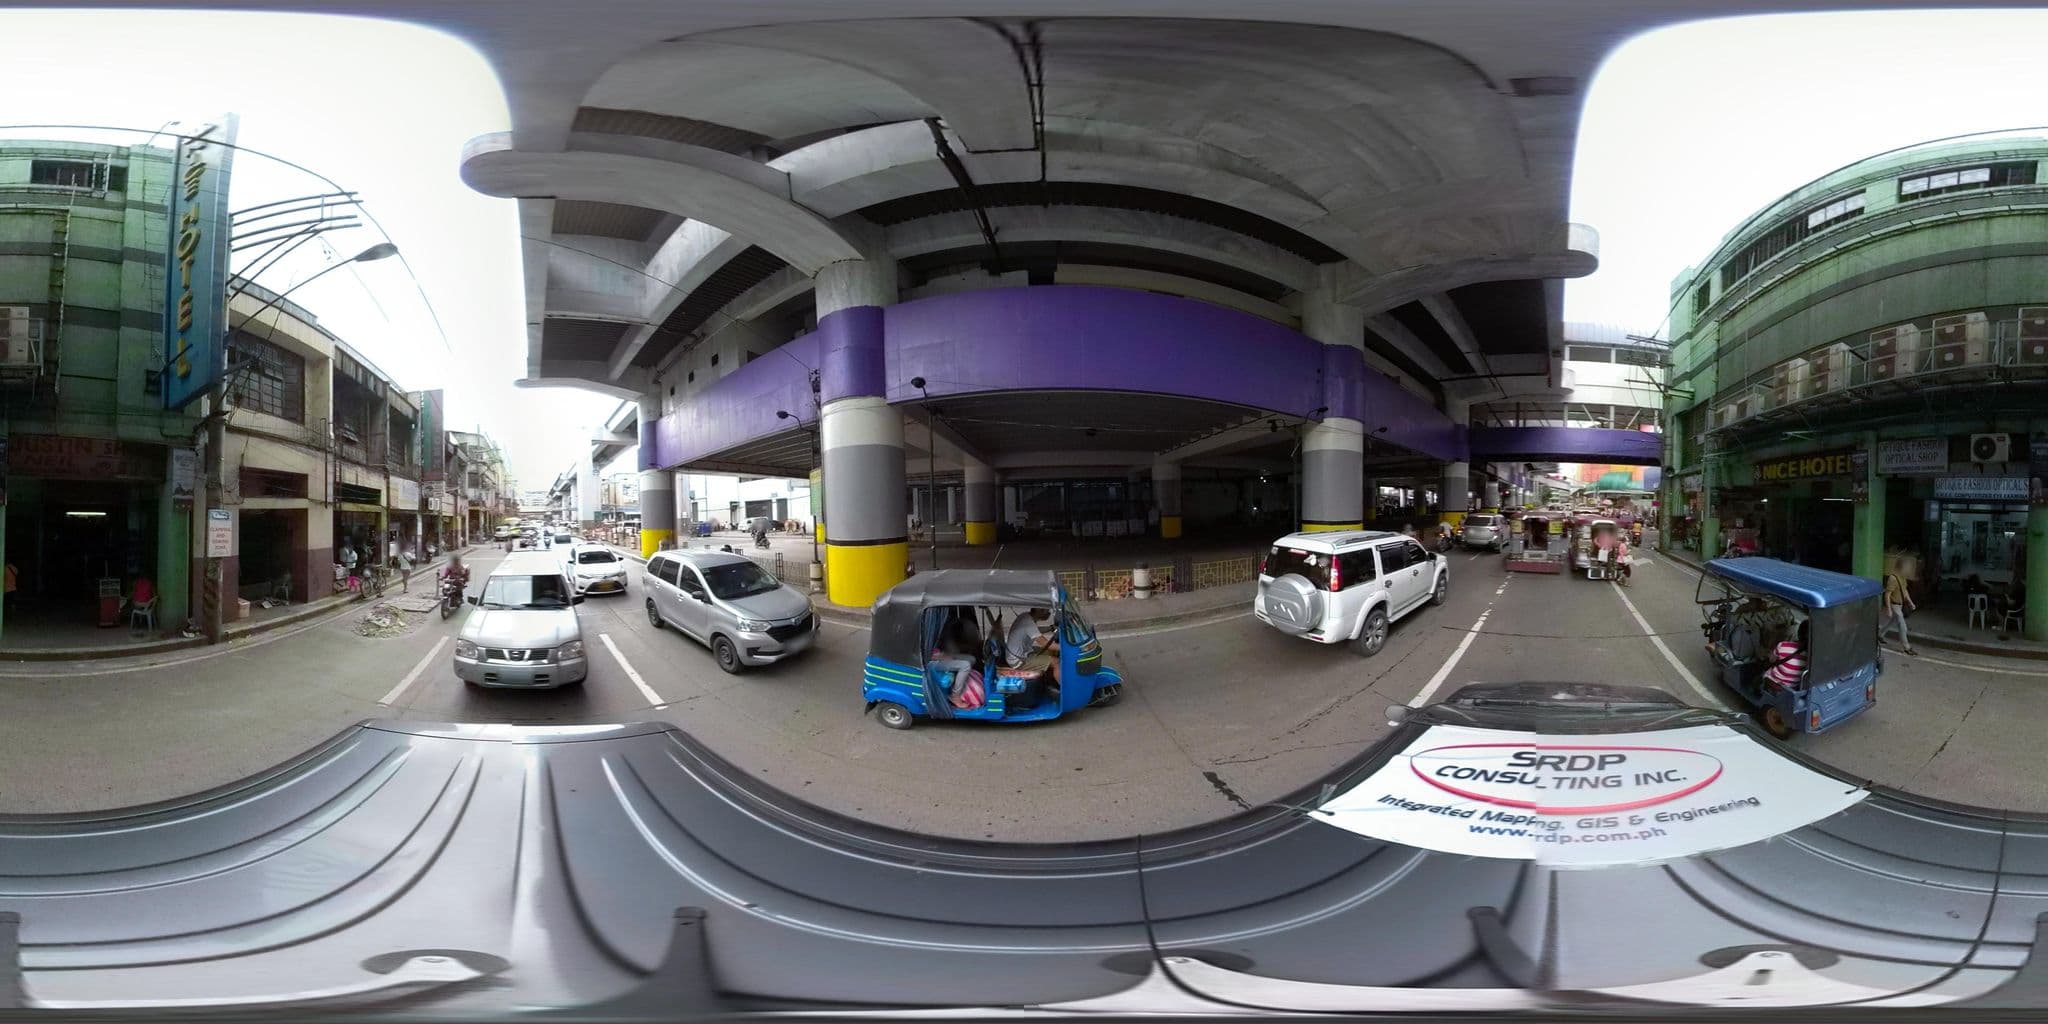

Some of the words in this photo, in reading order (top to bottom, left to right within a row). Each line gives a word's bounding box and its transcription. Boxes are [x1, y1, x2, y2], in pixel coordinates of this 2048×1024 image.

[176, 203, 203, 379] HOTEL
[1762, 461, 1797, 480] NICE
[1799, 453, 1853, 477] HOTEL
[1887, 452, 1916, 464] OPTICAL
[1919, 449, 1936, 463] SHOP
[1506, 751, 1627, 771] SRDP
[1635, 769, 1687, 786] INC.
[1377, 794, 1476, 818] Integrated
[1576, 816, 1619, 829] GIS
[1628, 815, 1645, 826] &
[1655, 795, 1761, 823] Engineering
[1469, 825, 1667, 844] www.rdp.com.ph
